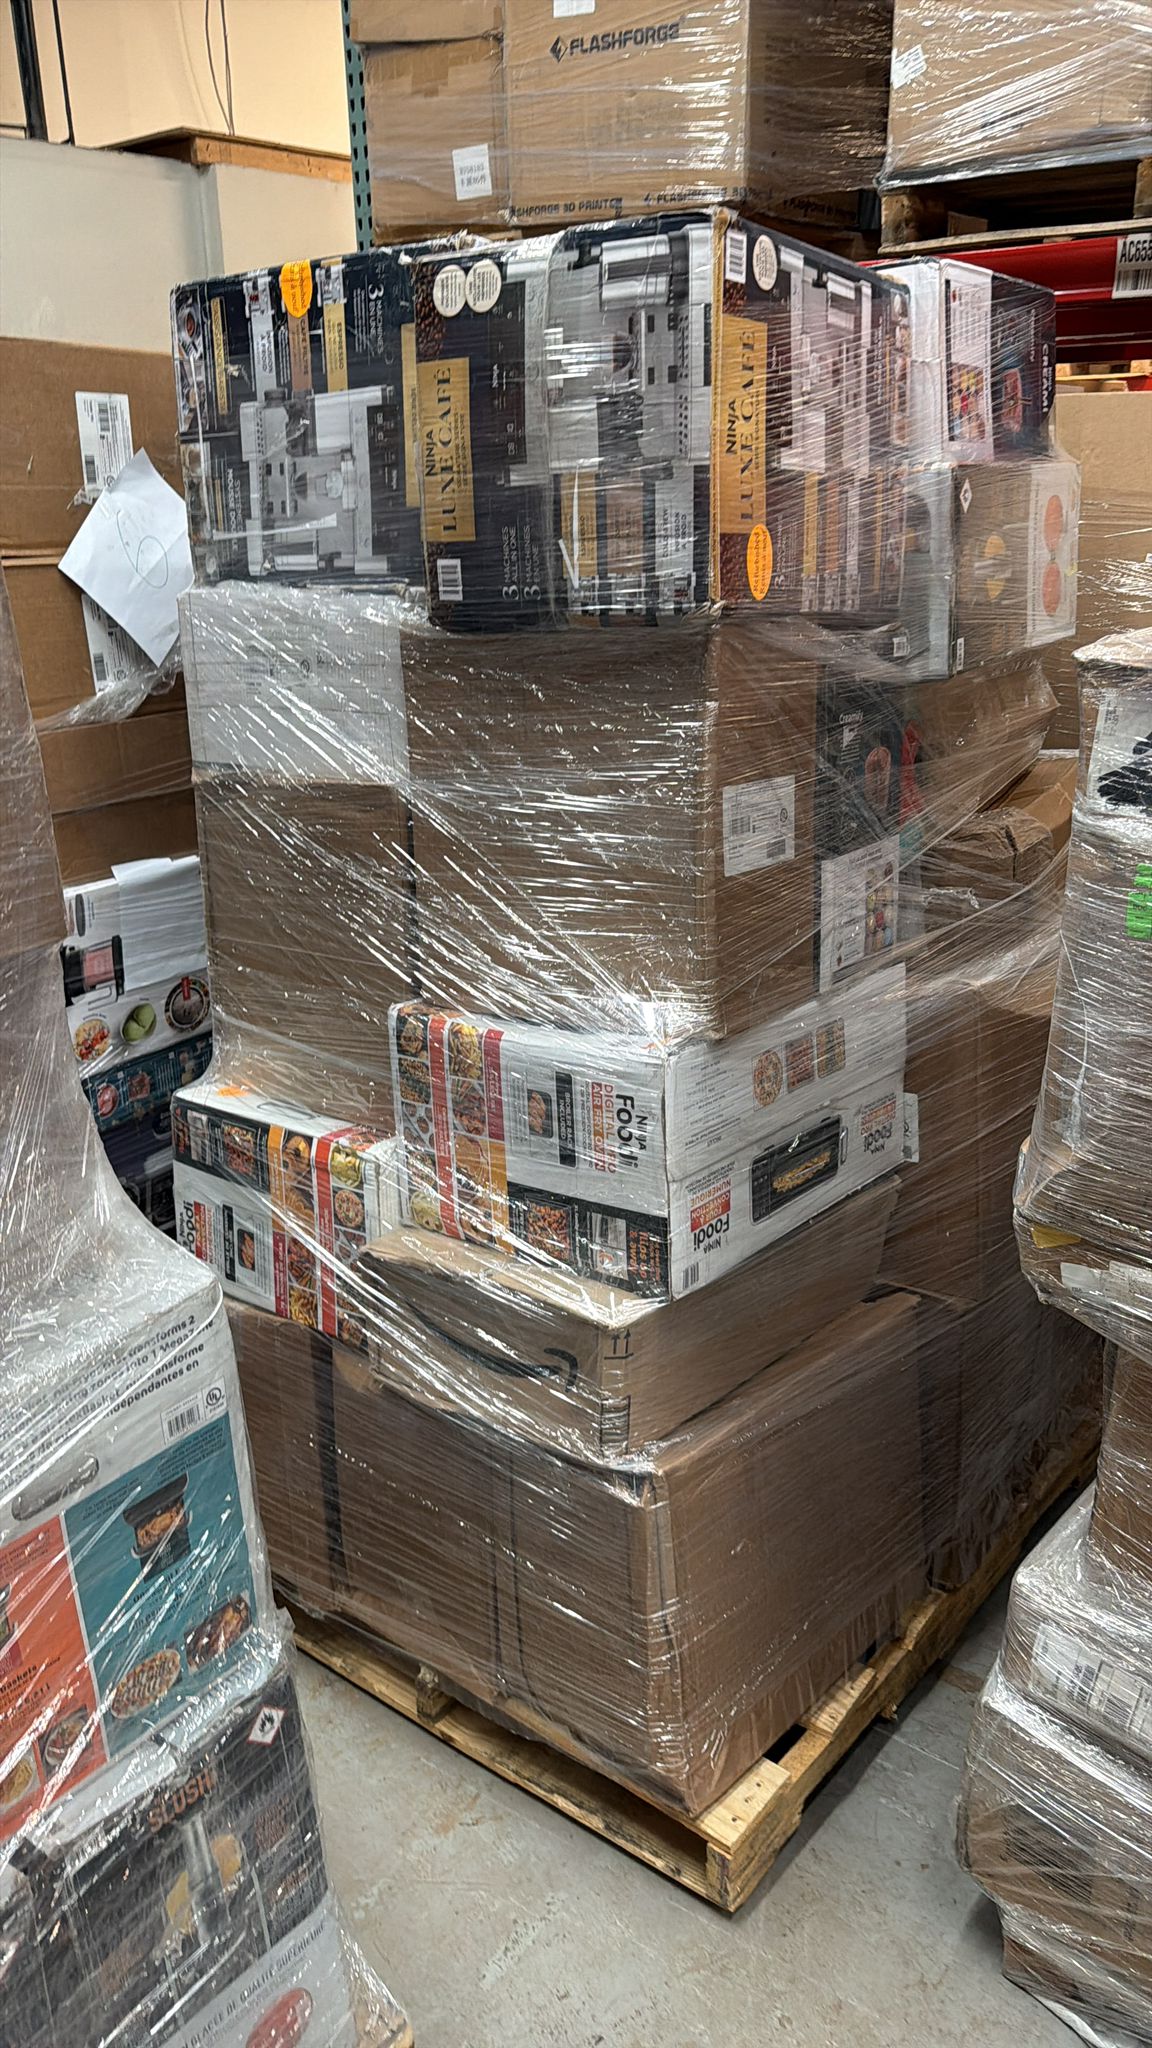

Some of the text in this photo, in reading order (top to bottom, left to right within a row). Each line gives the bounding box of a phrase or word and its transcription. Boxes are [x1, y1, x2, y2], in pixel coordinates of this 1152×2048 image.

[569, 22, 680, 56] FLASHFORGE
[368, 283, 384, 300] 3
[726, 399, 738, 455] NINJA
[425, 430, 438, 477] NINJA
[433, 367, 458, 533] LUXE CAFÉ
[740, 431, 755, 520] LUXE
[228, 511, 236, 551] DOULE
[509, 527, 517, 550] ONE
[502, 525, 511, 583] MACHINES
[511, 563, 519, 582] ALL
[523, 525, 532, 583] MACHINES
[752, 532, 761, 593] Refurbished
[502, 584, 520, 601] 3
[523, 584, 541, 601] 3
[592, 1084, 602, 1106] AIR
[604, 1084, 616, 1140] DIGITAL
[594, 1108, 603, 1133] FRY
[615, 1094, 638, 1169] Foodi
[635, 1114, 648, 1151] NINJA
[691, 1179, 731, 1207] NUMÉRIQUE
[693, 1213, 729, 1251] Foodi
[703, 1236, 721, 1254] NINJA
[188, 1314, 196, 1326] 2
[148, 1342, 205, 1381] ransforme
[186, 1359, 199, 1372] en
[147, 1767, 219, 1833] SLUSH
